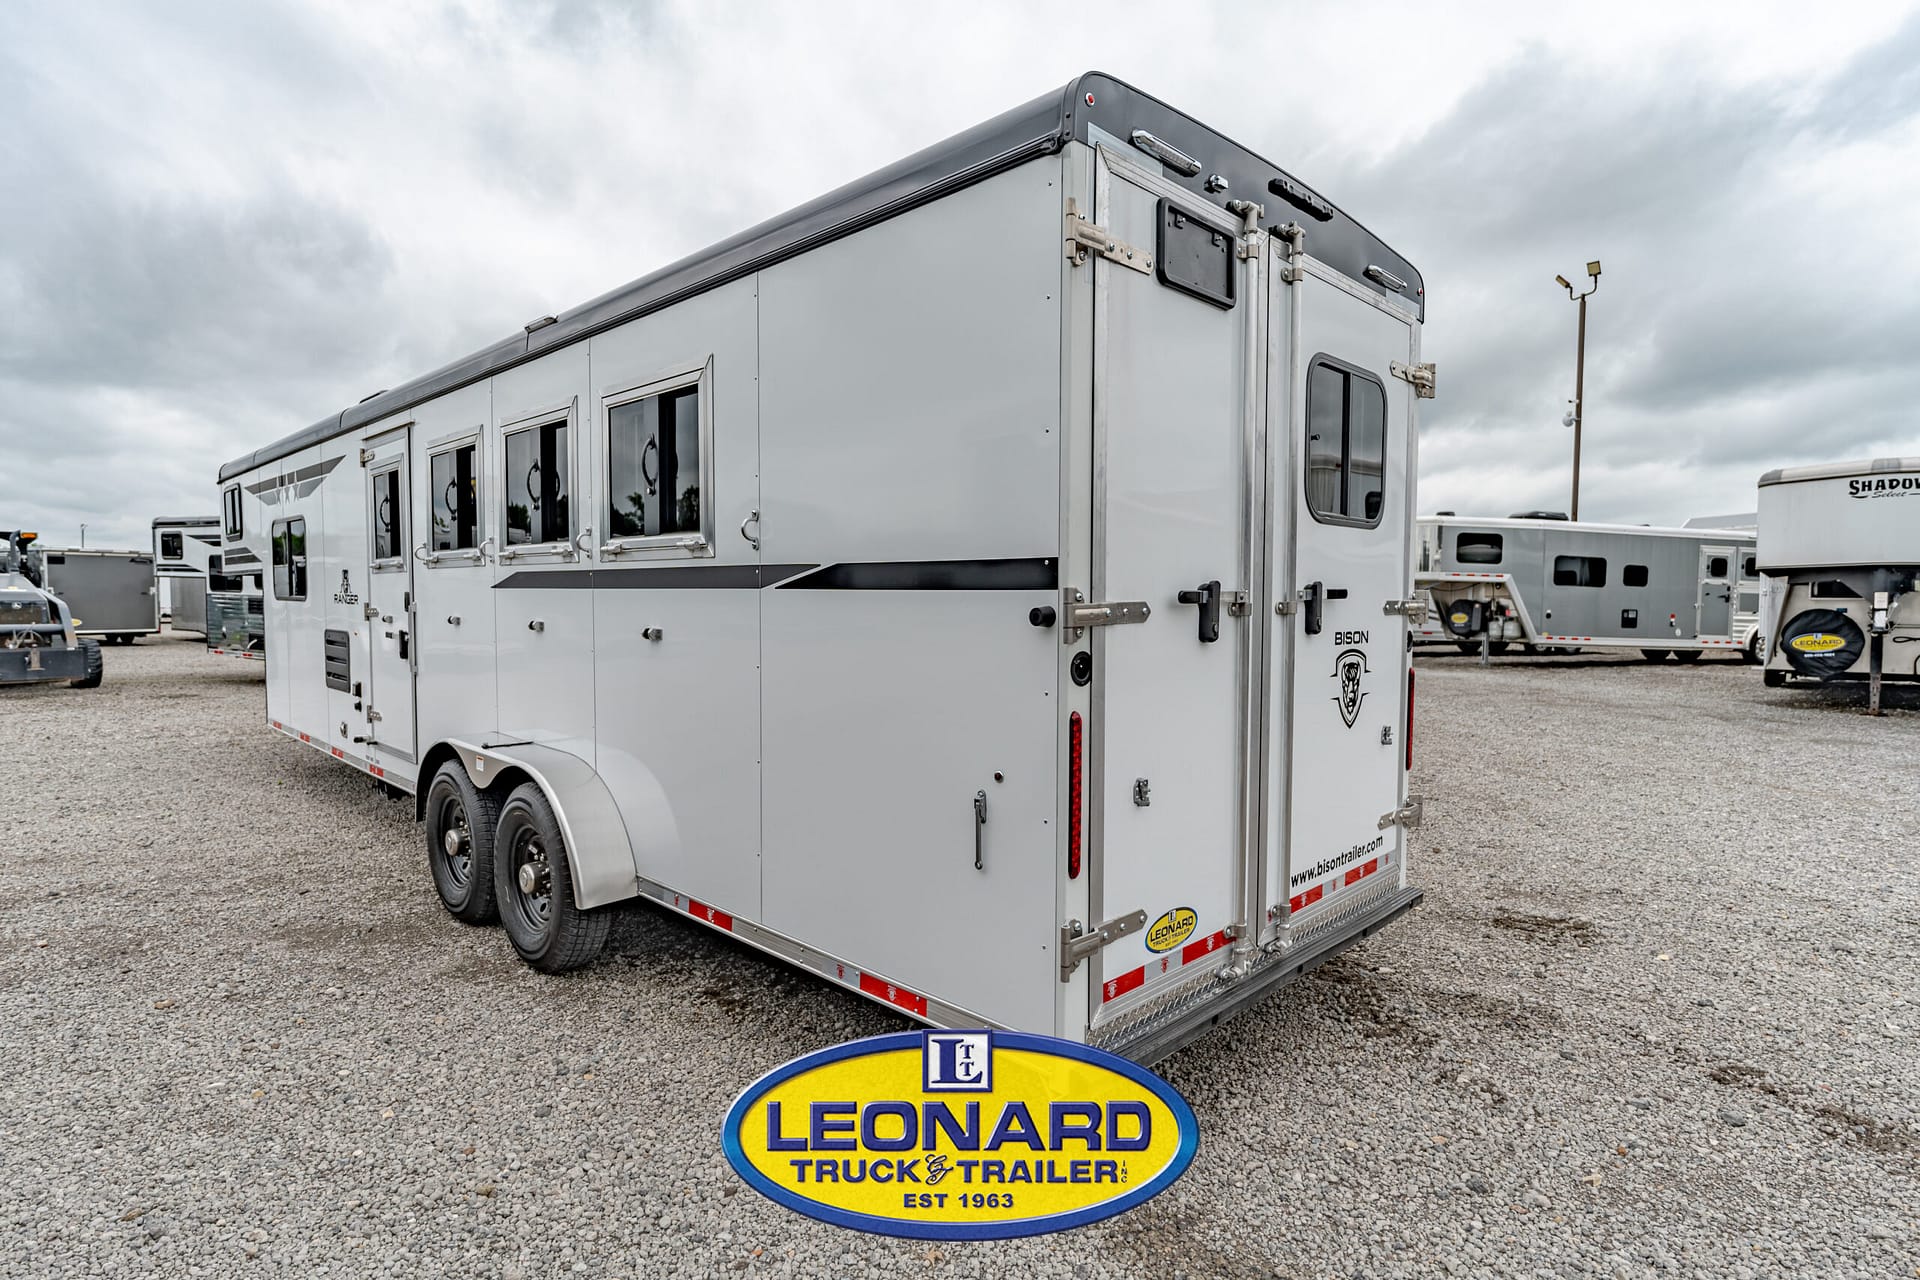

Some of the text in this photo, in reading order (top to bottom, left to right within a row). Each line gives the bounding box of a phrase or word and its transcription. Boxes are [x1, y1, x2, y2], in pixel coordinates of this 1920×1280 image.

[334, 593, 359, 604] RANGER
[1334, 630, 1369, 645] BISON
[1290, 835, 1383, 888] www.bisontrailer.com
[1150, 915, 1193, 942] LEONARD
